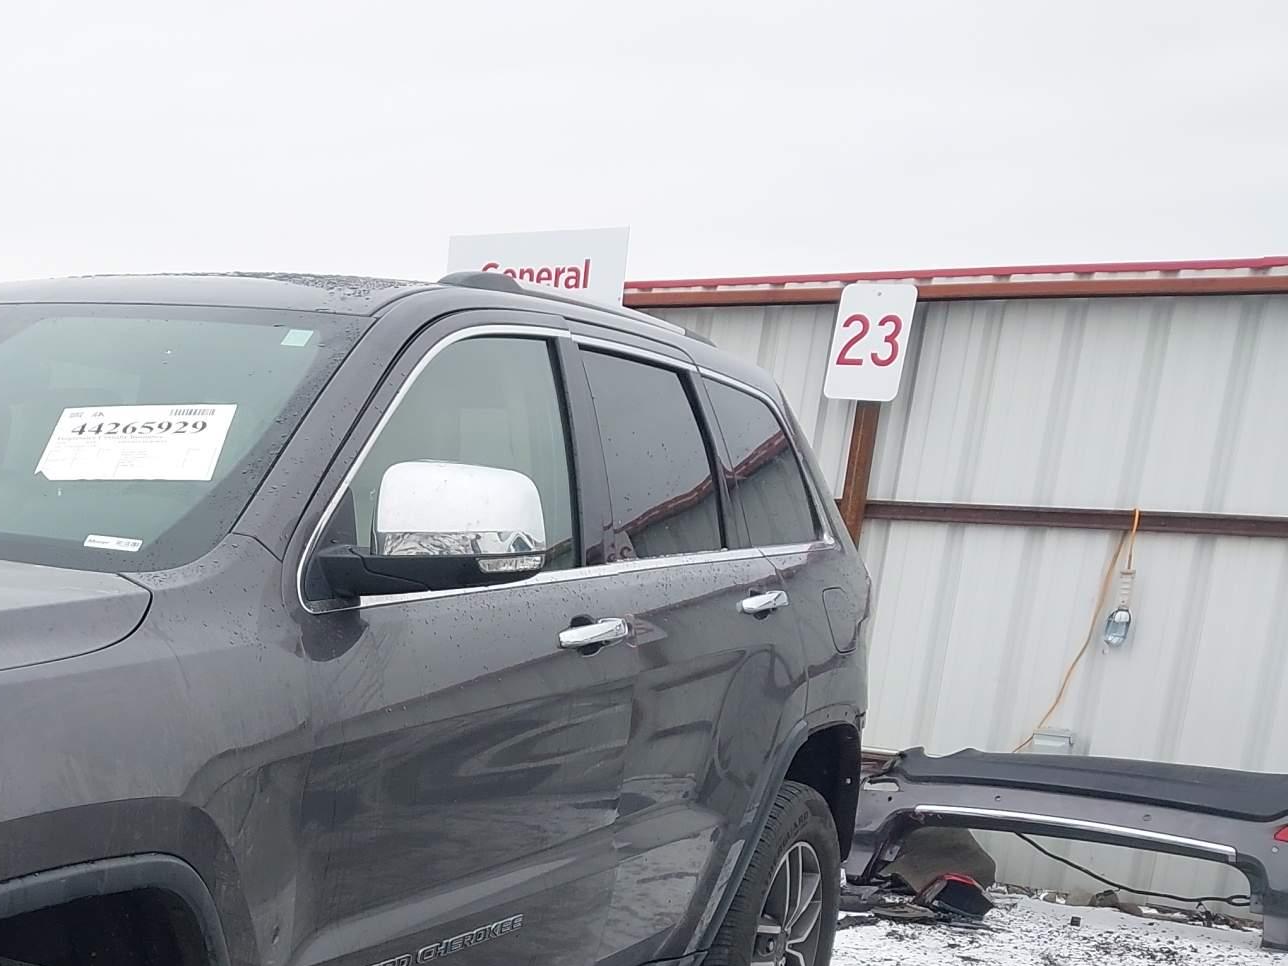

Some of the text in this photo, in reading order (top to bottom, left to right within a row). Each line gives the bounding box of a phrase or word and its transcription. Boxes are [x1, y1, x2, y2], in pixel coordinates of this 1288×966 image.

[835, 313, 903, 367] 23
[71, 420, 208, 435] 44265929
[416, 914, 524, 964] CHEROKEE
